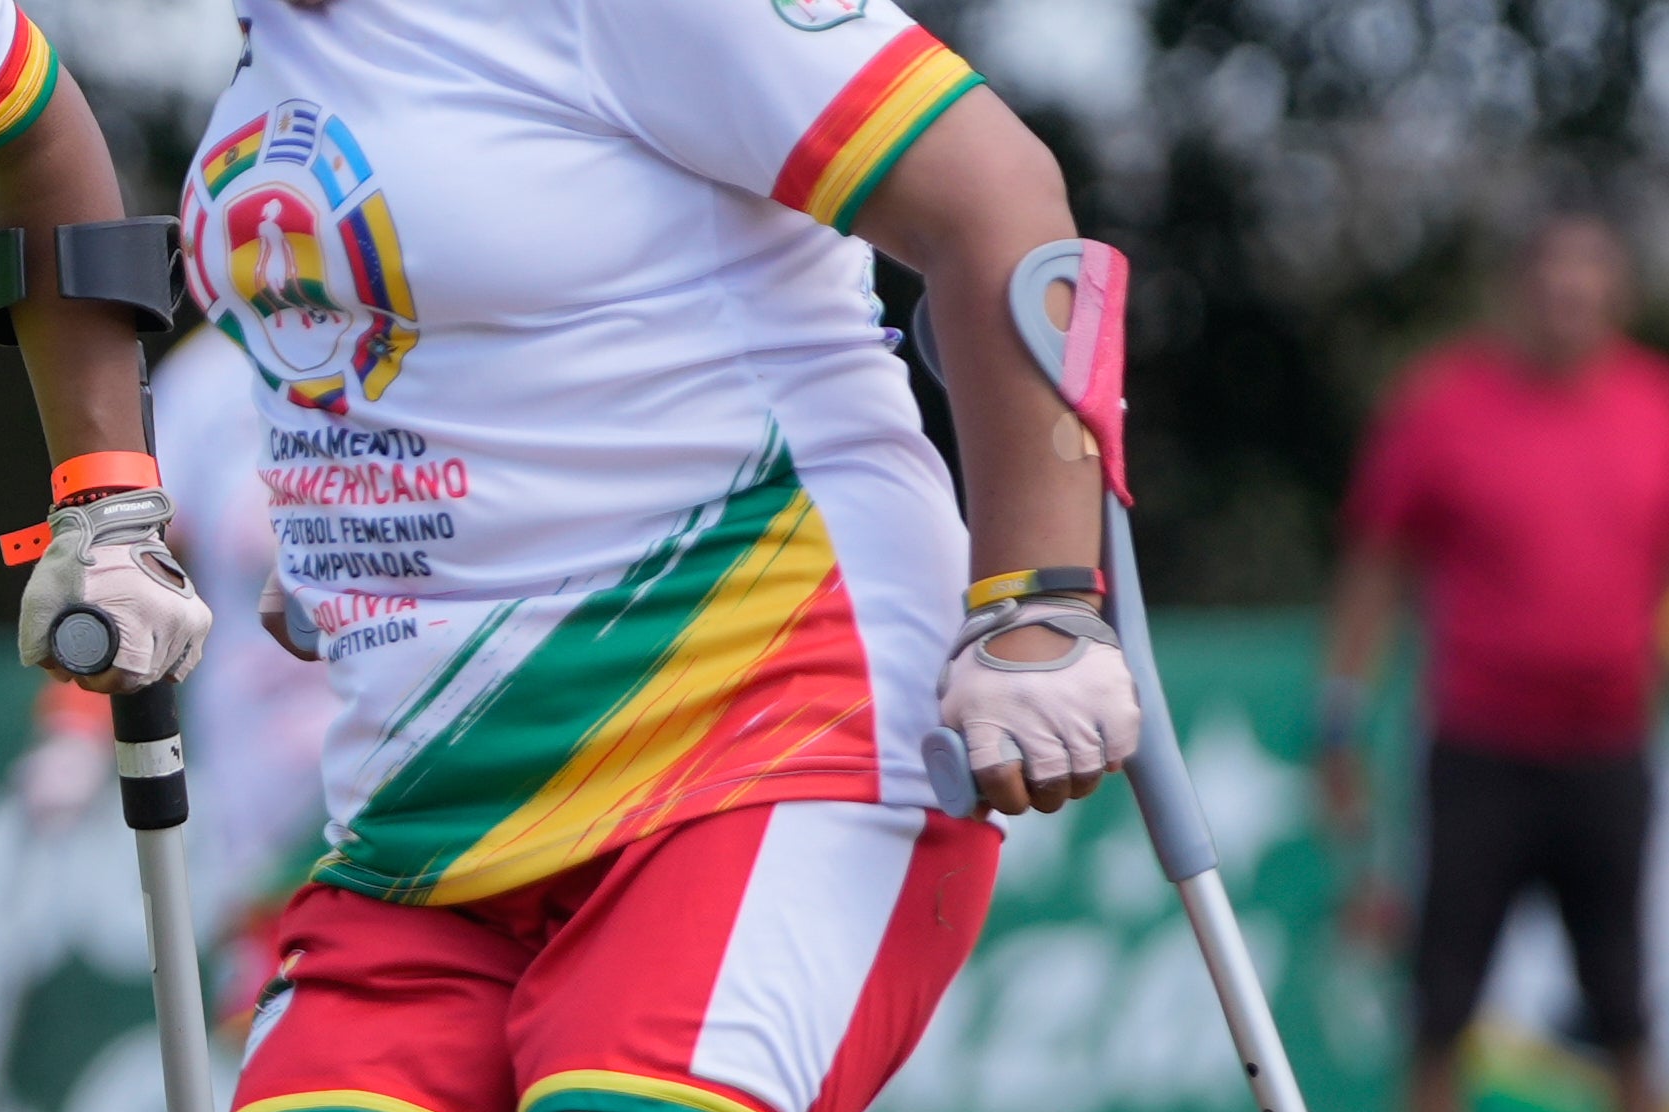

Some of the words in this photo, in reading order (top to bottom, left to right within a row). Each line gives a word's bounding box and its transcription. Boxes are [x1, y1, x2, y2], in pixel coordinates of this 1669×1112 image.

[340, 512, 455, 545] FEMENINO
[301, 550, 432, 581] AMPUTADAS
[312, 592, 419, 637] BOLIVIA
